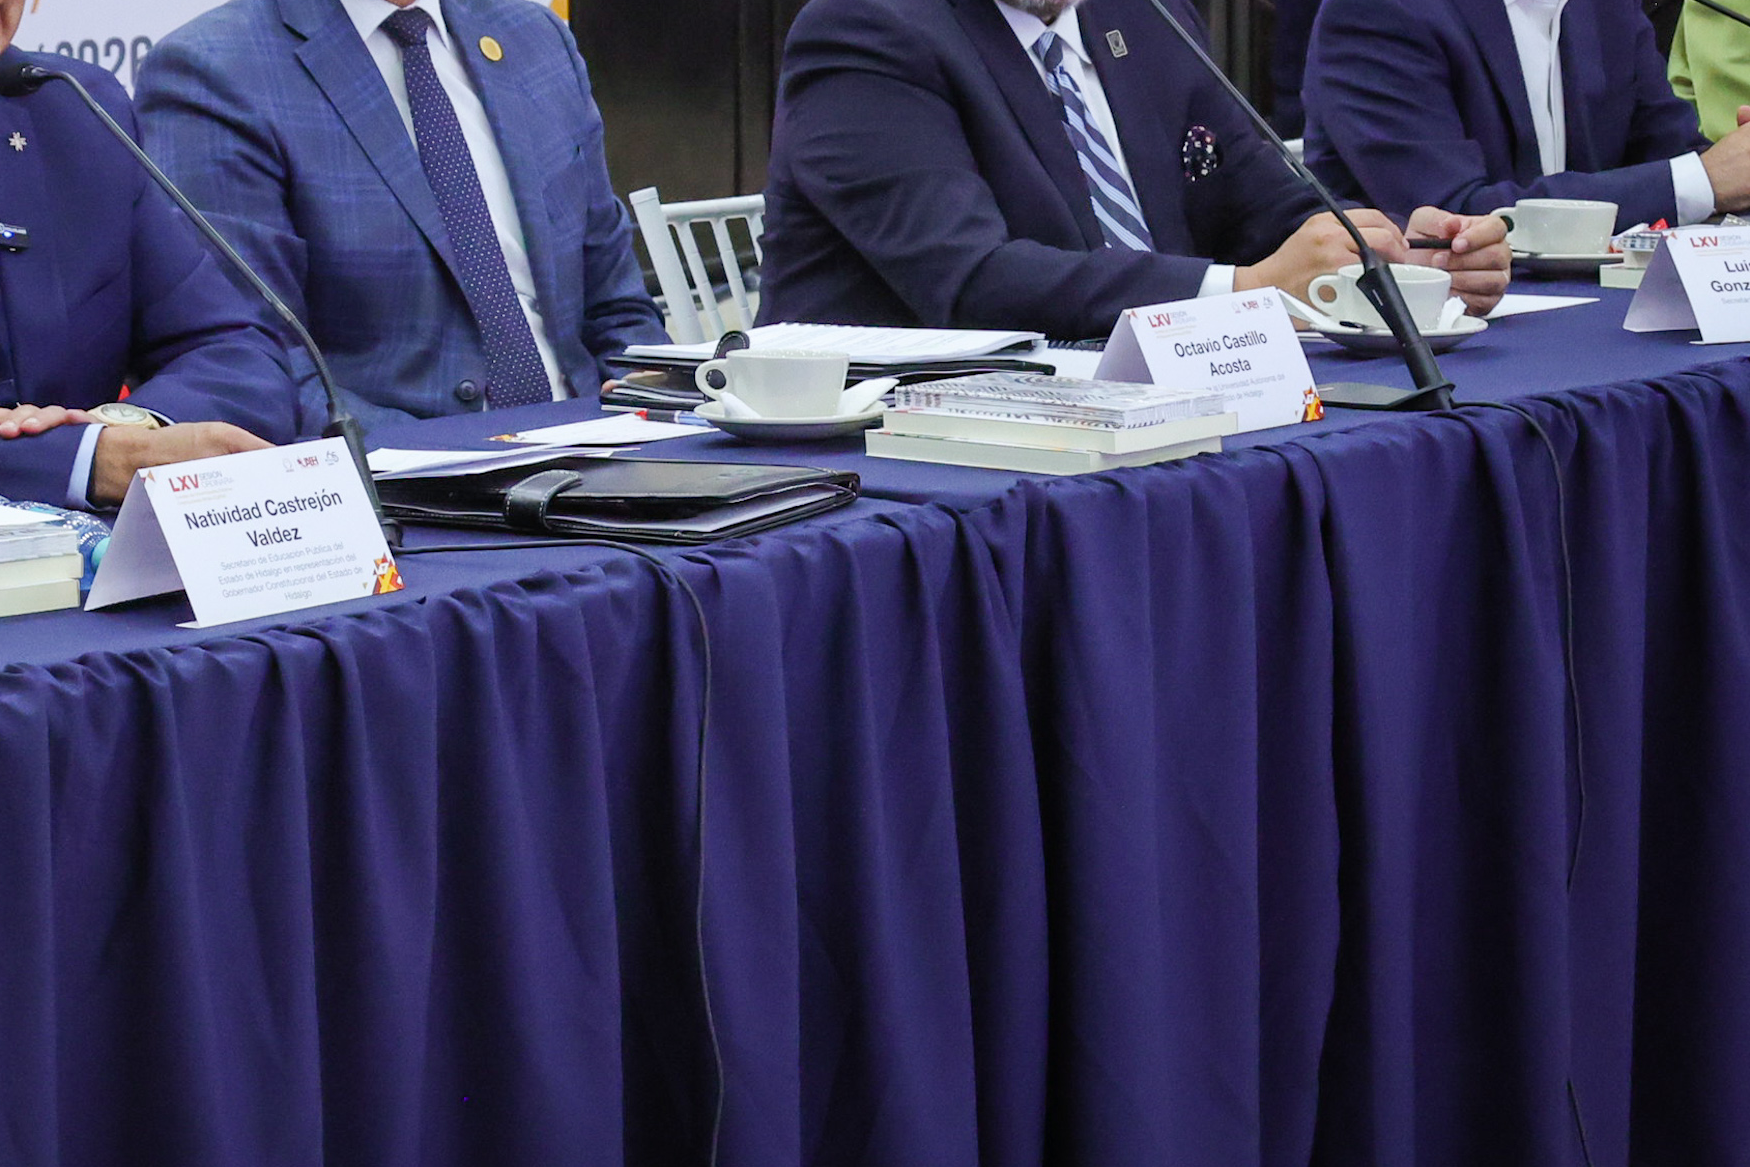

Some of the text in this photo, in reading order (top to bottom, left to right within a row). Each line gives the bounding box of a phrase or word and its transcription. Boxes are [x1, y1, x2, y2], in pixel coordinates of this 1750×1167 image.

[1690, 236, 1718, 248] LXV
[1710, 279, 1750, 293] Gonz
[1147, 313, 1172, 328] LXV
[1174, 330, 1268, 358] Octavio Castillo
[1210, 358, 1252, 377] Acosta
[168, 474, 200, 493] LXV
[184, 502, 262, 530] Natividad
[264, 488, 343, 516] Castrejón
[246, 527, 303, 548] Valdez
